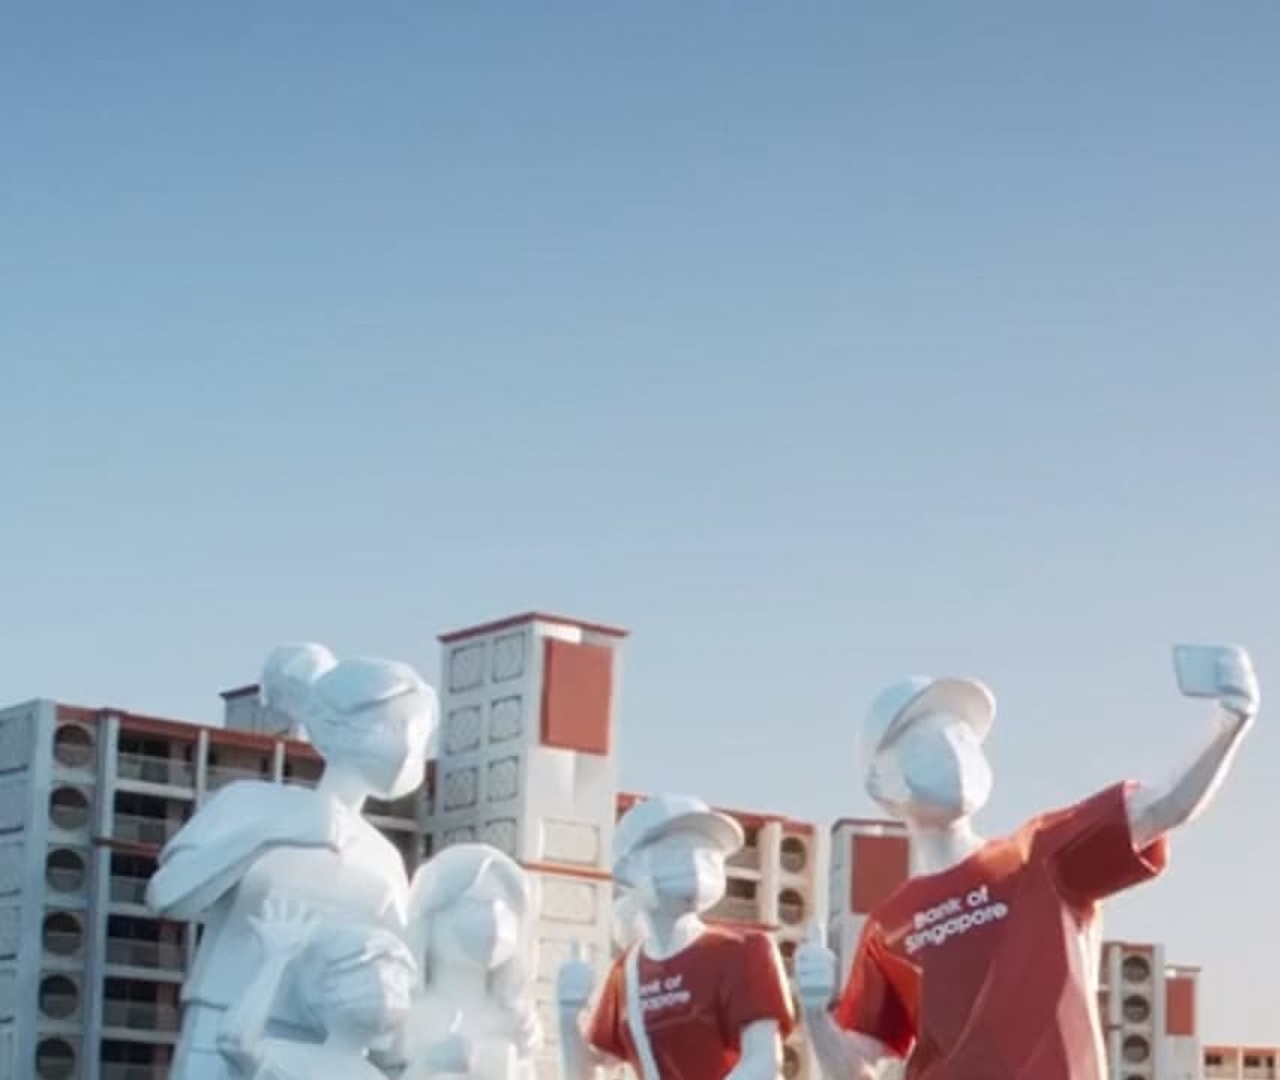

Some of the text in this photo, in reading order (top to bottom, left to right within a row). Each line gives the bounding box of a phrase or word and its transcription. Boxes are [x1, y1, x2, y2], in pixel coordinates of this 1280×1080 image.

[904, 902, 1009, 954] Singapore
[913, 884, 989, 930] Bank of
